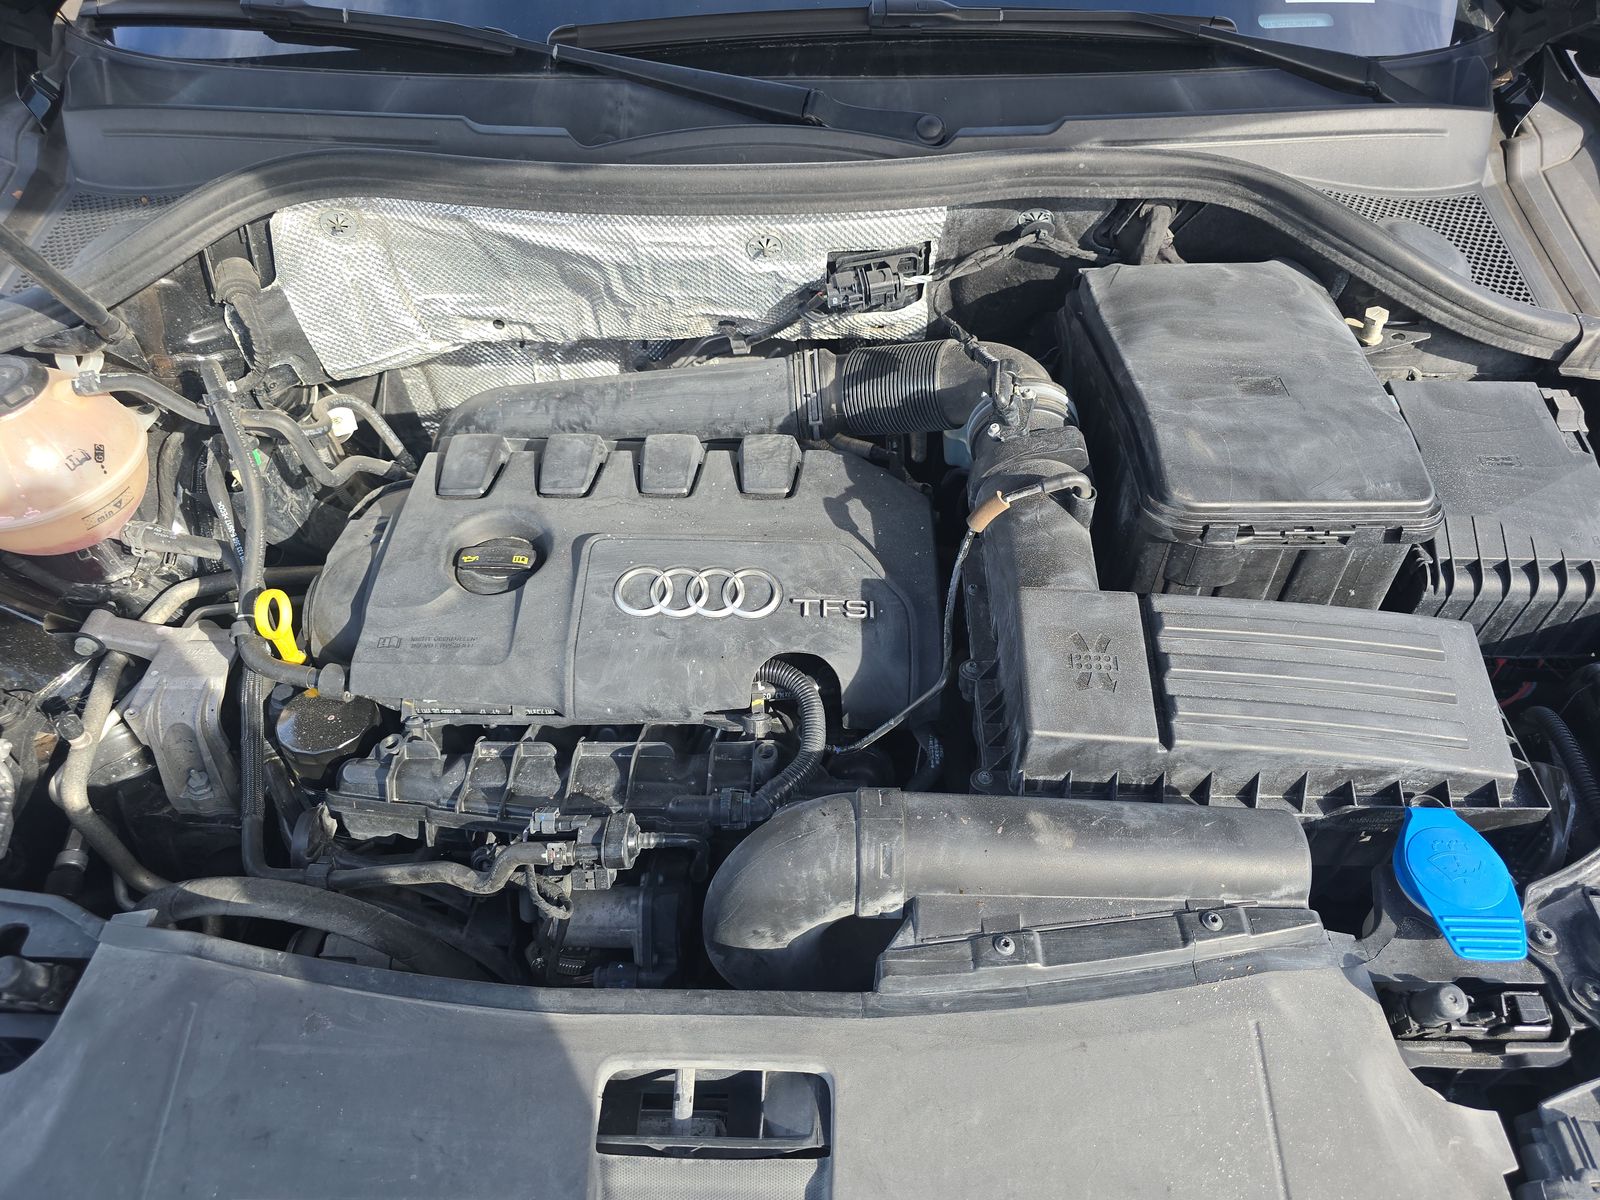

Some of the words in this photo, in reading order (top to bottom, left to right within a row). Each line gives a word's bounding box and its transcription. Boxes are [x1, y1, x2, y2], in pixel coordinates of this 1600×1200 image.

[95, 444, 104, 462] G12
[97, 511, 114, 523] min
[790, 598, 875, 619] TFSI
